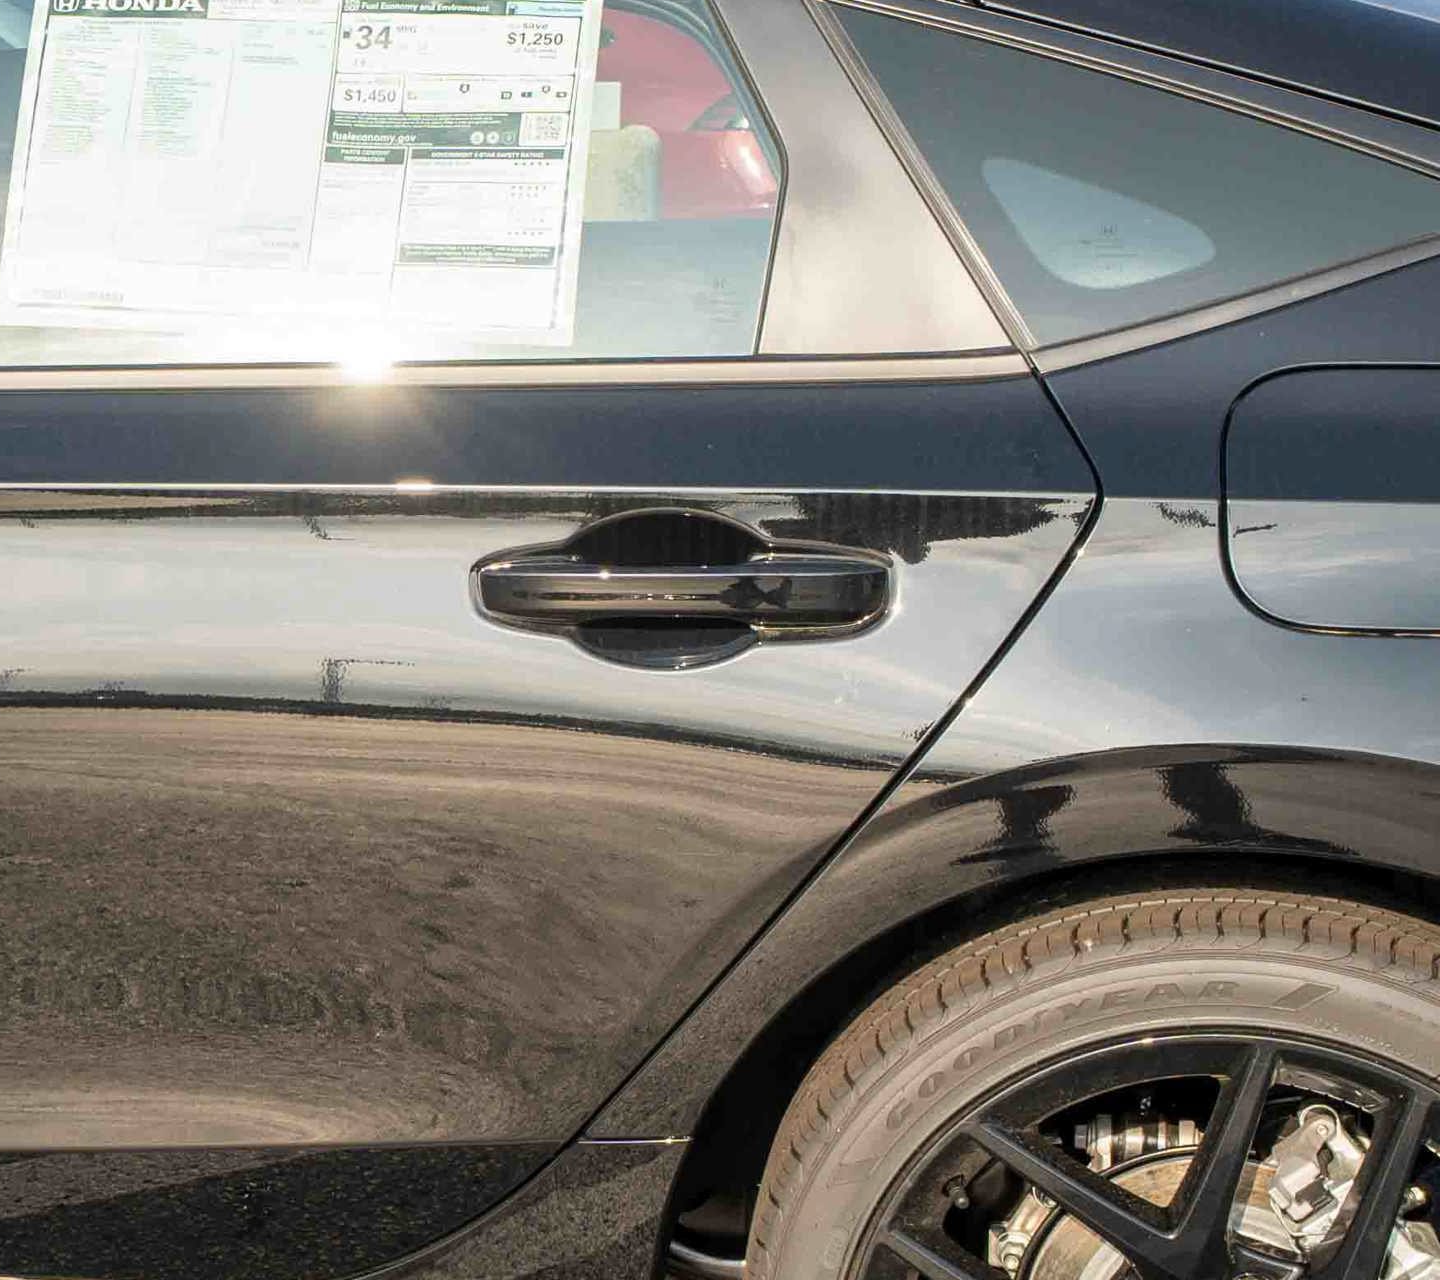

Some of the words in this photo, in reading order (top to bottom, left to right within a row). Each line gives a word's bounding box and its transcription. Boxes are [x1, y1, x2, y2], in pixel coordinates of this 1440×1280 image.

[380, 2, 417, 13] Economy
[437, 3, 489, 12] Environment
[355, 25, 393, 50] 34
[507, 32, 564, 47] $1,250
[344, 88, 396, 103] $1,450
[332, 131, 416, 144] fueleconomy.gov
[886, 980, 1241, 1130] GOODYEAR
